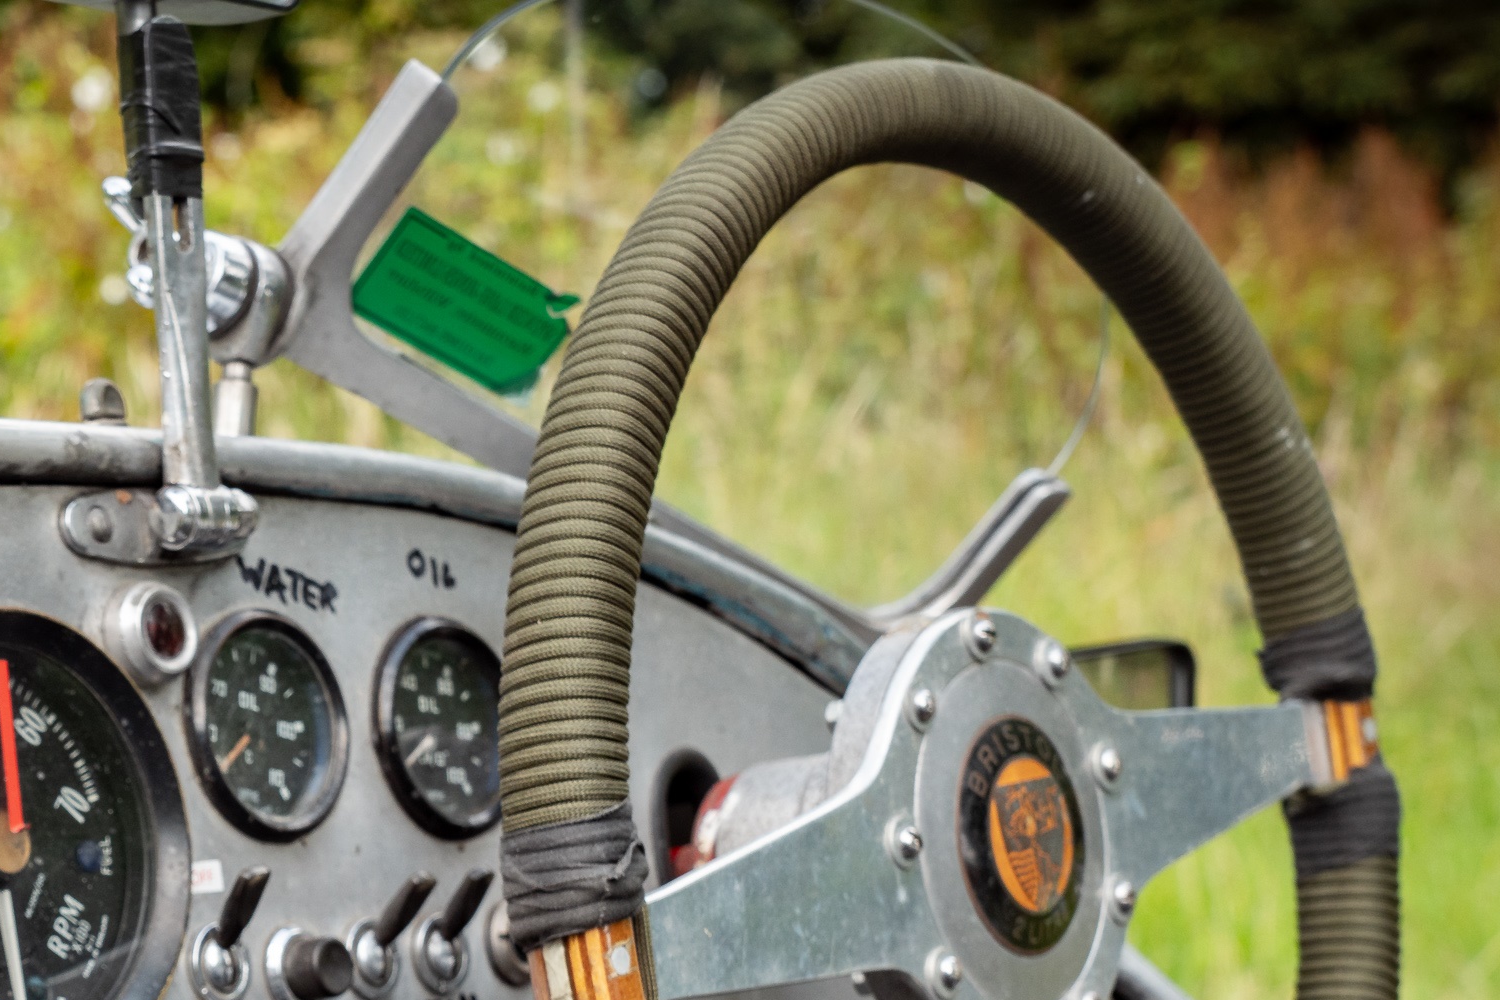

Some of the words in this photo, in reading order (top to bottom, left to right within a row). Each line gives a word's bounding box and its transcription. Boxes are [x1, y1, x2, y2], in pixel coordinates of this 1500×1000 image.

[235, 553, 338, 614] WATER
[13, 706, 48, 746] 60
[53, 786, 91, 824] 70
[47, 894, 86, 960] RPM
